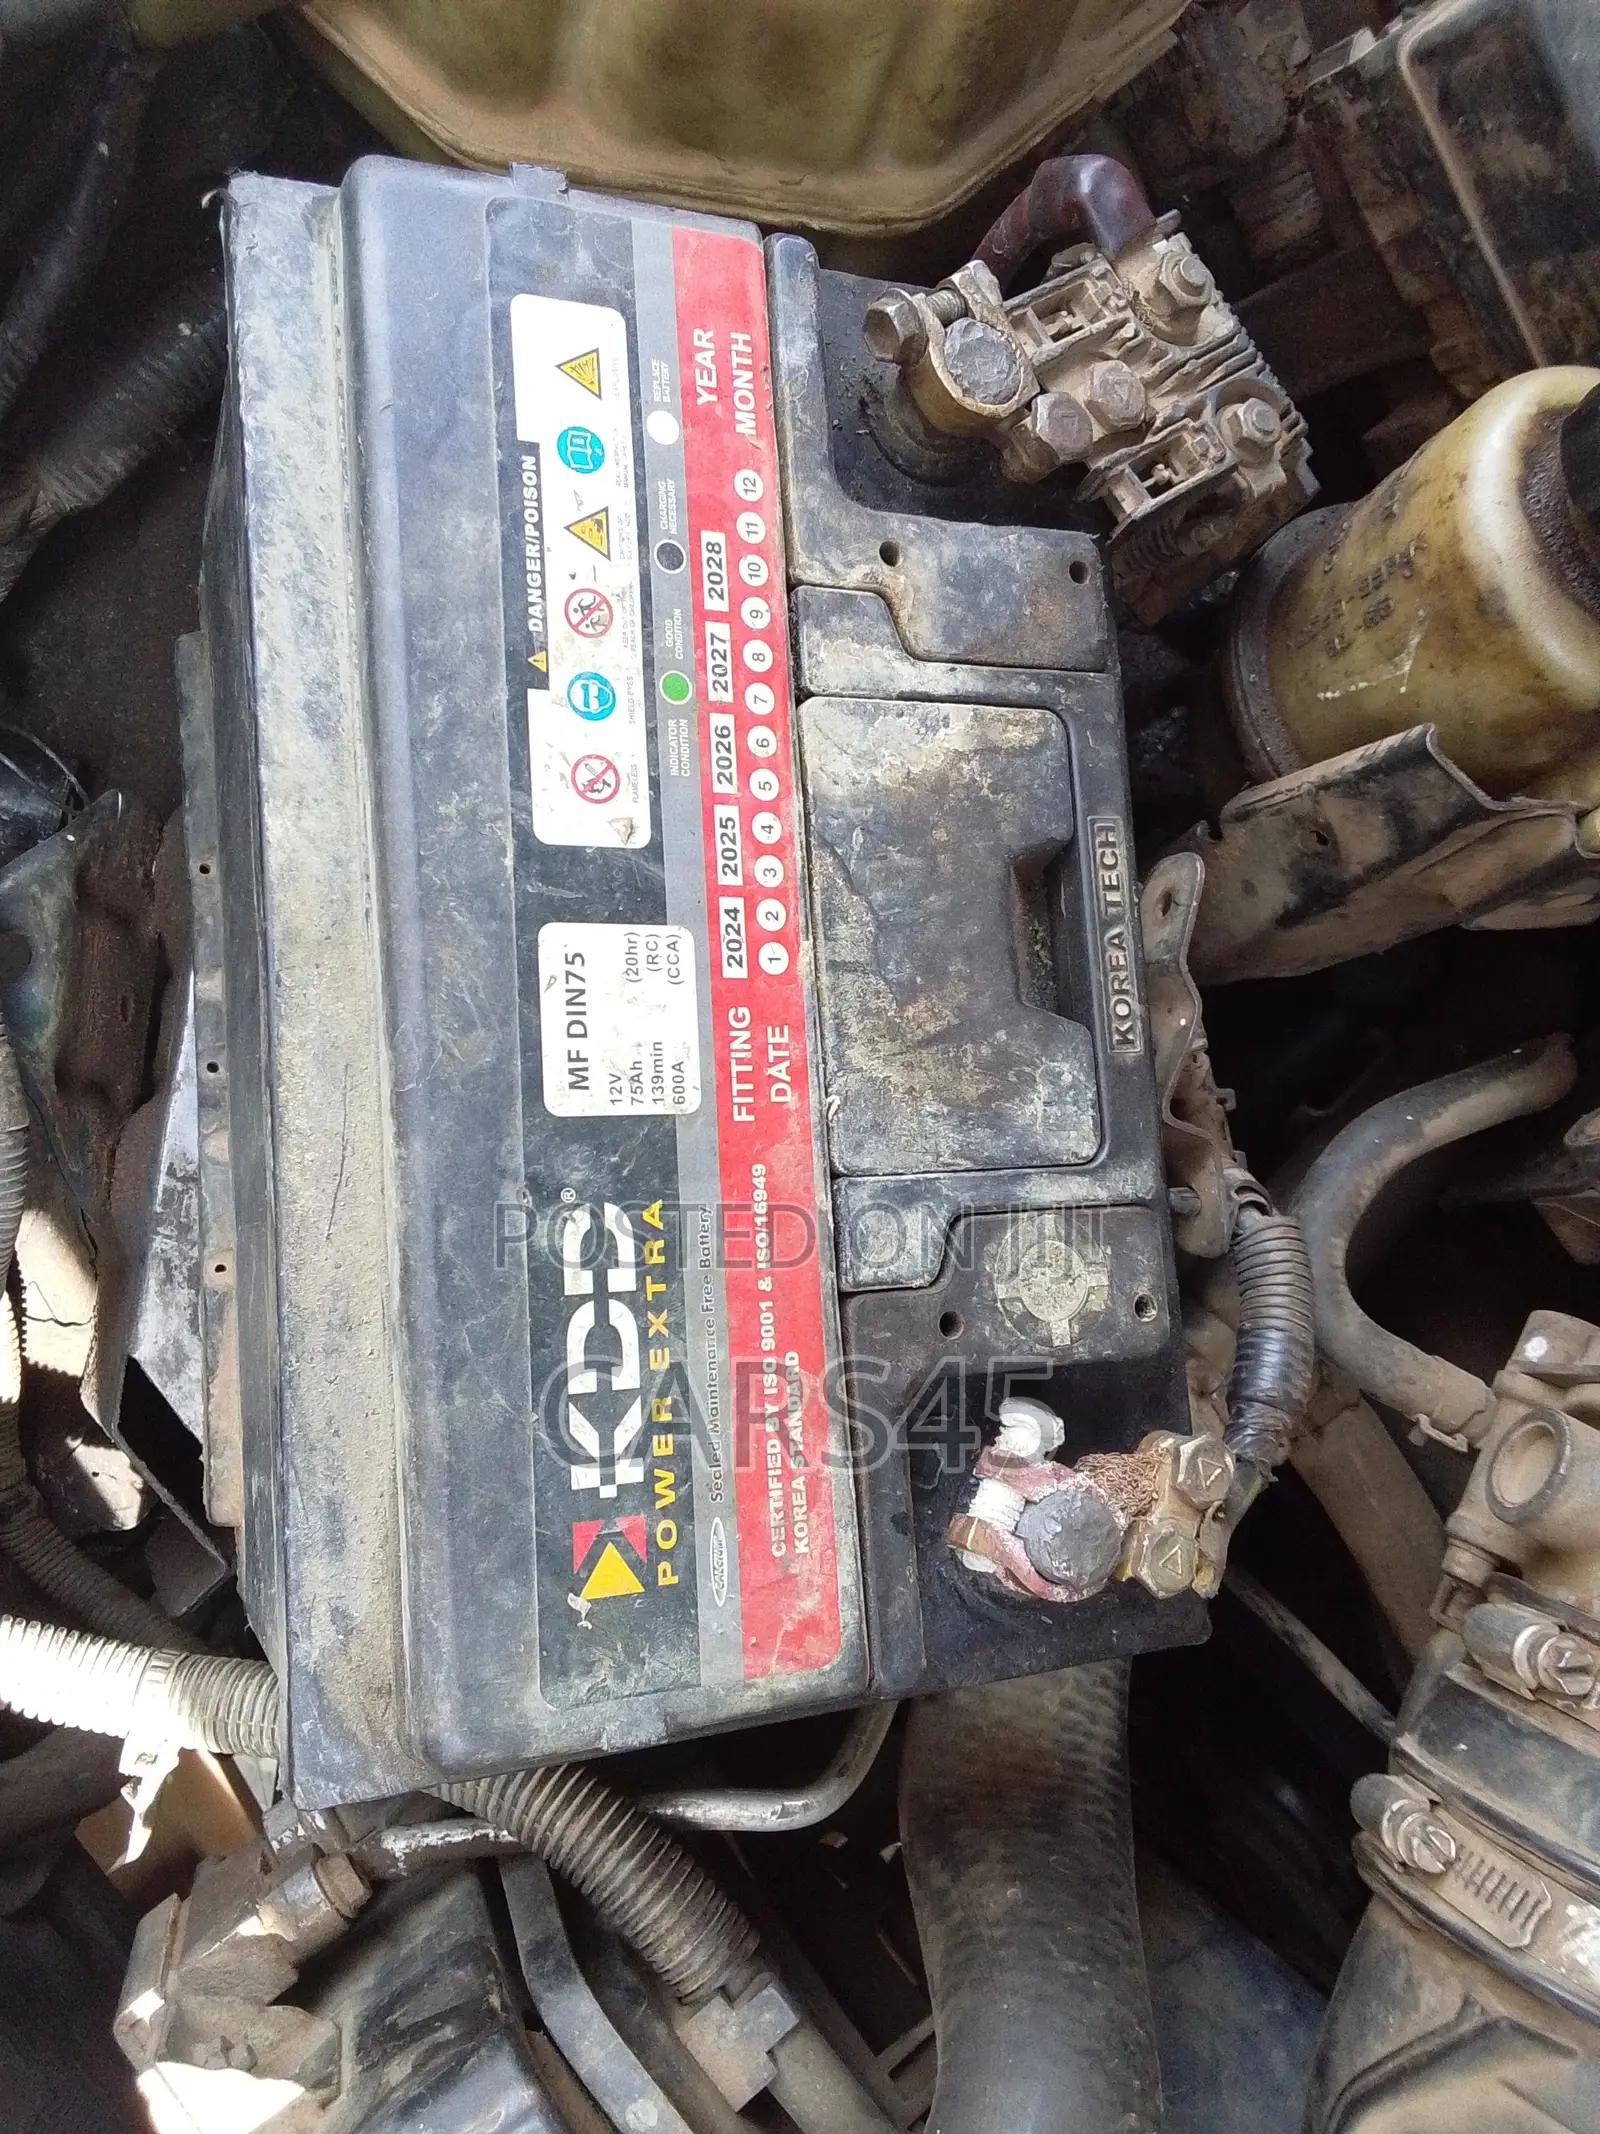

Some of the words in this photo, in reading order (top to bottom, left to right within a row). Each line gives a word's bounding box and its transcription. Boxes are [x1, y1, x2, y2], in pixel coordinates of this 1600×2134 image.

[651, 359, 661, 402] REPLACE
[661, 361, 671, 402] BATTERY
[694, 329, 717, 405] YEAR
[730, 333, 757, 435] MONTH
[658, 480, 668, 530] CHARGING
[667, 478, 678, 534] NECESSARY
[743, 477, 757, 495] 12
[522, 455, 544, 632] DANGER/POISON
[745, 522, 758, 537] 11
[706, 541, 724, 601] 2028
[748, 562, 761, 580] 10
[665, 619, 673, 647] GOOD
[673, 609, 684, 659] CONDITION
[750, 609, 763, 619] 9
[710, 633, 729, 693] 2027
[752, 653, 766, 663] 8
[626, 676, 634, 695] EYES
[754, 695, 768, 705] 7
[627, 698, 635, 724] SHIELD
[668, 719, 679, 776] INDICATOR
[679, 719, 691, 777] CONDITION
[715, 725, 733, 784] 2026
[756, 738, 770, 748] 6
[631, 764, 639, 803] FLAMELESS
[759, 782, 772, 791] 5
[720, 817, 738, 876] 2025
[761, 824, 774, 834] 4
[764, 868, 777, 877] 3
[1096, 828, 1121, 914] TECH
[725, 907, 742, 968] 2024
[766, 911, 779, 921] 2
[624, 932, 642, 983] (20hr)
[646, 934, 662, 972] (RC)
[666, 934, 684, 985] (CCA)
[768, 956, 781, 964] 1
[564, 952, 587, 1039] DIN75
[1104, 928, 1134, 1046] KOREA
[568, 1050, 589, 1090] MF
[610, 1073, 622, 1105] 12V
[630, 1061, 643, 1105] 75Ah
[650, 1041, 664, 1104] 139min
[671, 1061, 685, 1104] 600A
[729, 1007, 754, 1121] FITTING
[768, 1026, 792, 1103] DATE
[697, 1204, 713, 1269] Battery
[751, 1163, 772, 1269] ISO/16949
[641, 1199, 670, 1370] EXTRA
[699, 1274, 714, 1313] Free
[757, 1276, 773, 1292] &
[759, 1300, 776, 1351] 9001
[702, 1319, 721, 1434] Maintenance
[761, 1357, 778, 1395] ISO
[764, 1402, 781, 1431] BY
[784, 1351, 805, 1468] STANDARD
[649, 1395, 679, 1585] POWER
[705, 1441, 724, 1502] Sealed
[765, 1439, 786, 1557] CERTIFIED
[791, 1477, 809, 1553] KOREA
